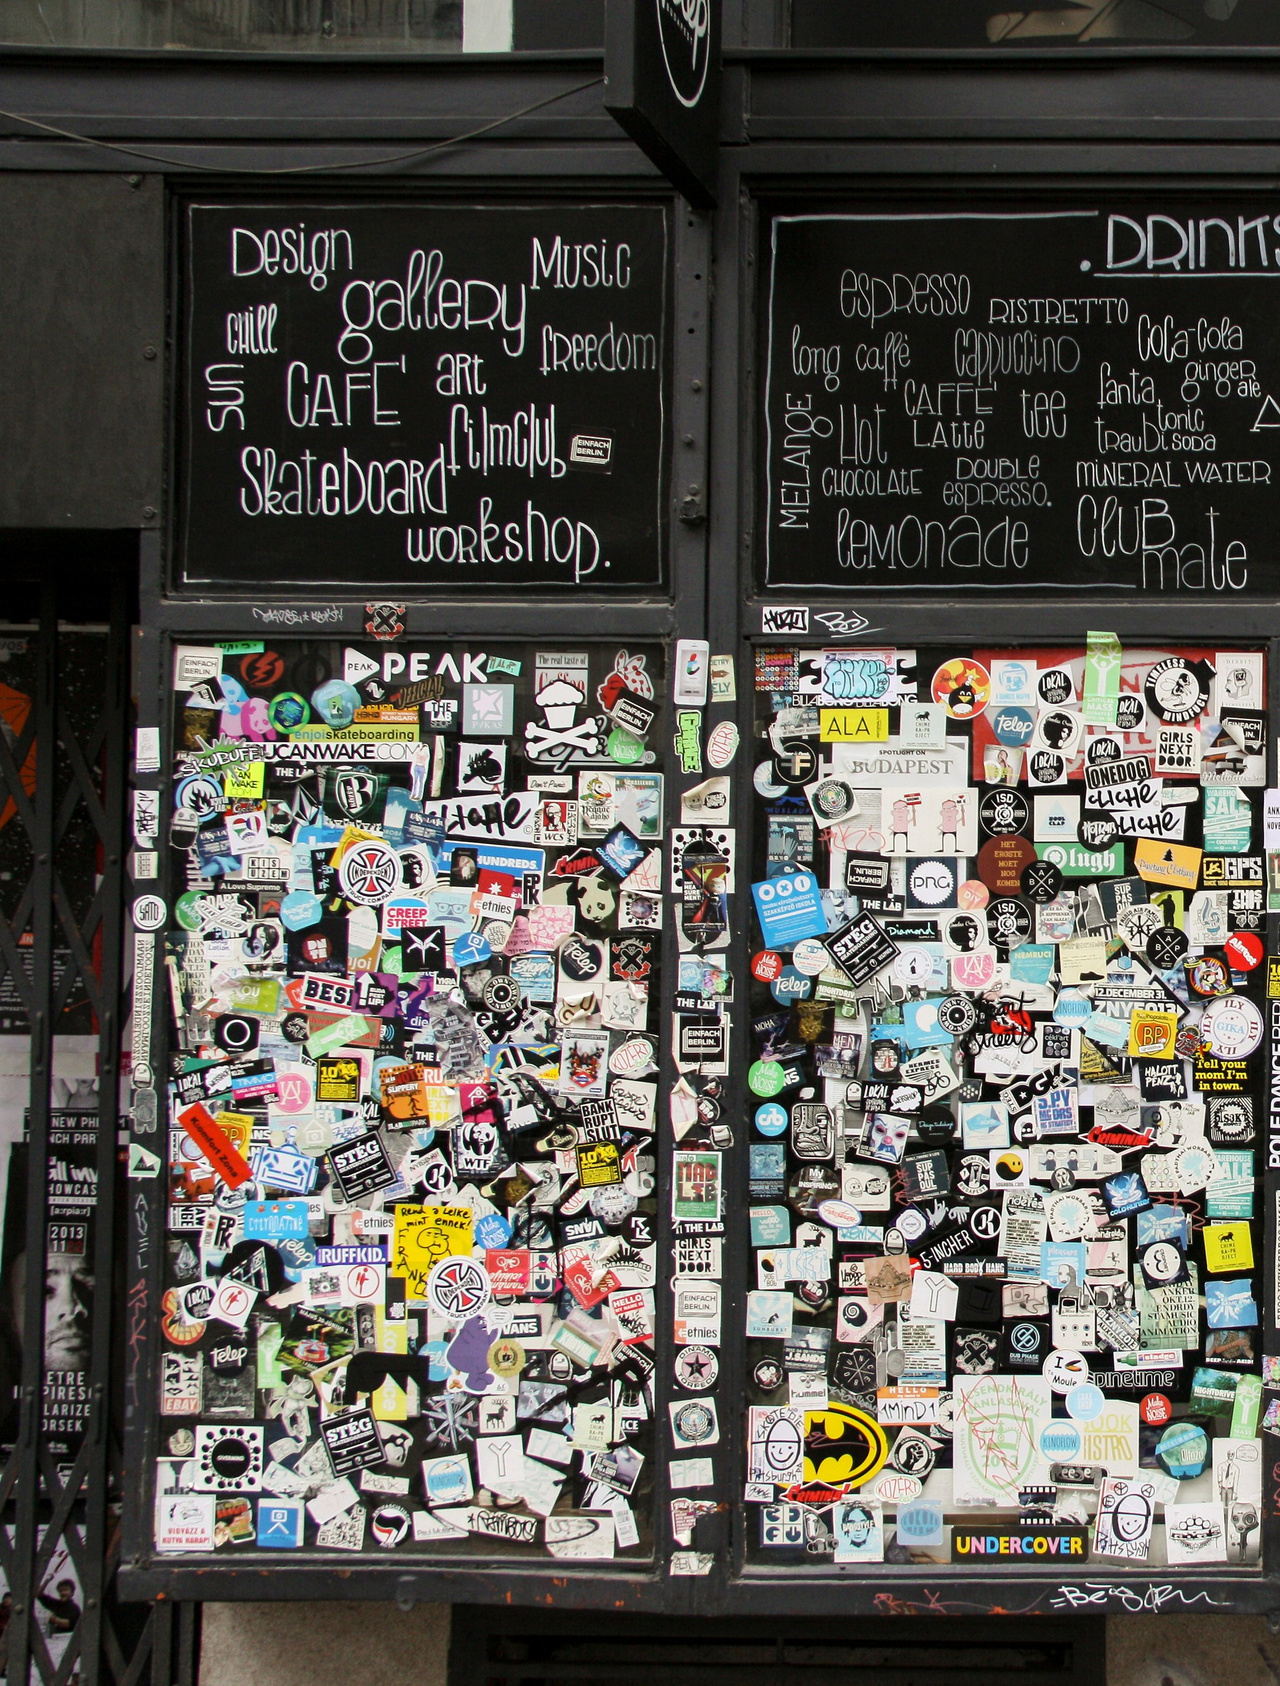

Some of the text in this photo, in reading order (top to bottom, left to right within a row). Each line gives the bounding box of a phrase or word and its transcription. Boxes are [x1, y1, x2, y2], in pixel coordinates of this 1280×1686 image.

[232, 223, 353, 291] Design
[531, 236, 631, 290] Music
[338, 249, 526, 365] gallery
[988, 298, 1129, 324] RISTRETTO
[540, 322, 656, 376] freedom
[792, 325, 840, 392] long
[437, 353, 487, 395] art
[1238, 379, 1262, 398] ale
[1020, 390, 1067, 438] tee
[840, 404, 888, 465] Hot
[578, 438, 610, 451] EINFACH
[577, 448, 606, 459] BERLIN.
[241, 443, 447, 516] Skateboard
[1184, 461, 1272, 485] WATER
[1143, 507, 1248, 589] mate
[1146, 658, 1186, 689] TIMELESS
[1162, 693, 1209, 722] MINDFUCK
[826, 716, 871, 736] ALA
[1160, 731, 1193, 743] GIRLS
[1159, 744, 1192, 755] NEXT
[850, 759, 954, 775] BUDAPEST
[1159, 756, 1195, 767] DOOR.
[1089, 760, 1149, 784] ONEDOG
[1226, 857, 1263, 879] GPS
[387, 908, 427, 918] CREEP
[481, 900, 512, 916] etnies
[387, 918, 427, 928] STREET
[688, 1030, 720, 1038] EINFACH
[688, 1038, 716, 1046] BERLIN.
[1197, 1059, 1247, 1071] Tell your
[1195, 1069, 1247, 1080] mom I'm
[1199, 1080, 1243, 1091] in town.
[582, 1101, 614, 1116] BANK
[584, 1113, 615, 1129] RUPT
[587, 1125, 619, 1141] SLUT
[188, 1115, 238, 1178] Komfort Zona
[334, 1140, 381, 1169] STÉG
[464, 1157, 490, 1170] WTF
[679, 1239, 712, 1249] GIRLS
[921, 1230, 973, 1269] 5-INCHER
[321, 1247, 387, 1264] RUFFKID.
[679, 1251, 710, 1261] NEXT
[678, 1262, 716, 1273] DOOR.
[687, 1327, 718, 1339] etnies
[164, 1397, 199, 1412] EBAY
[956, 1536, 1083, 1554] UNDERCOVER
